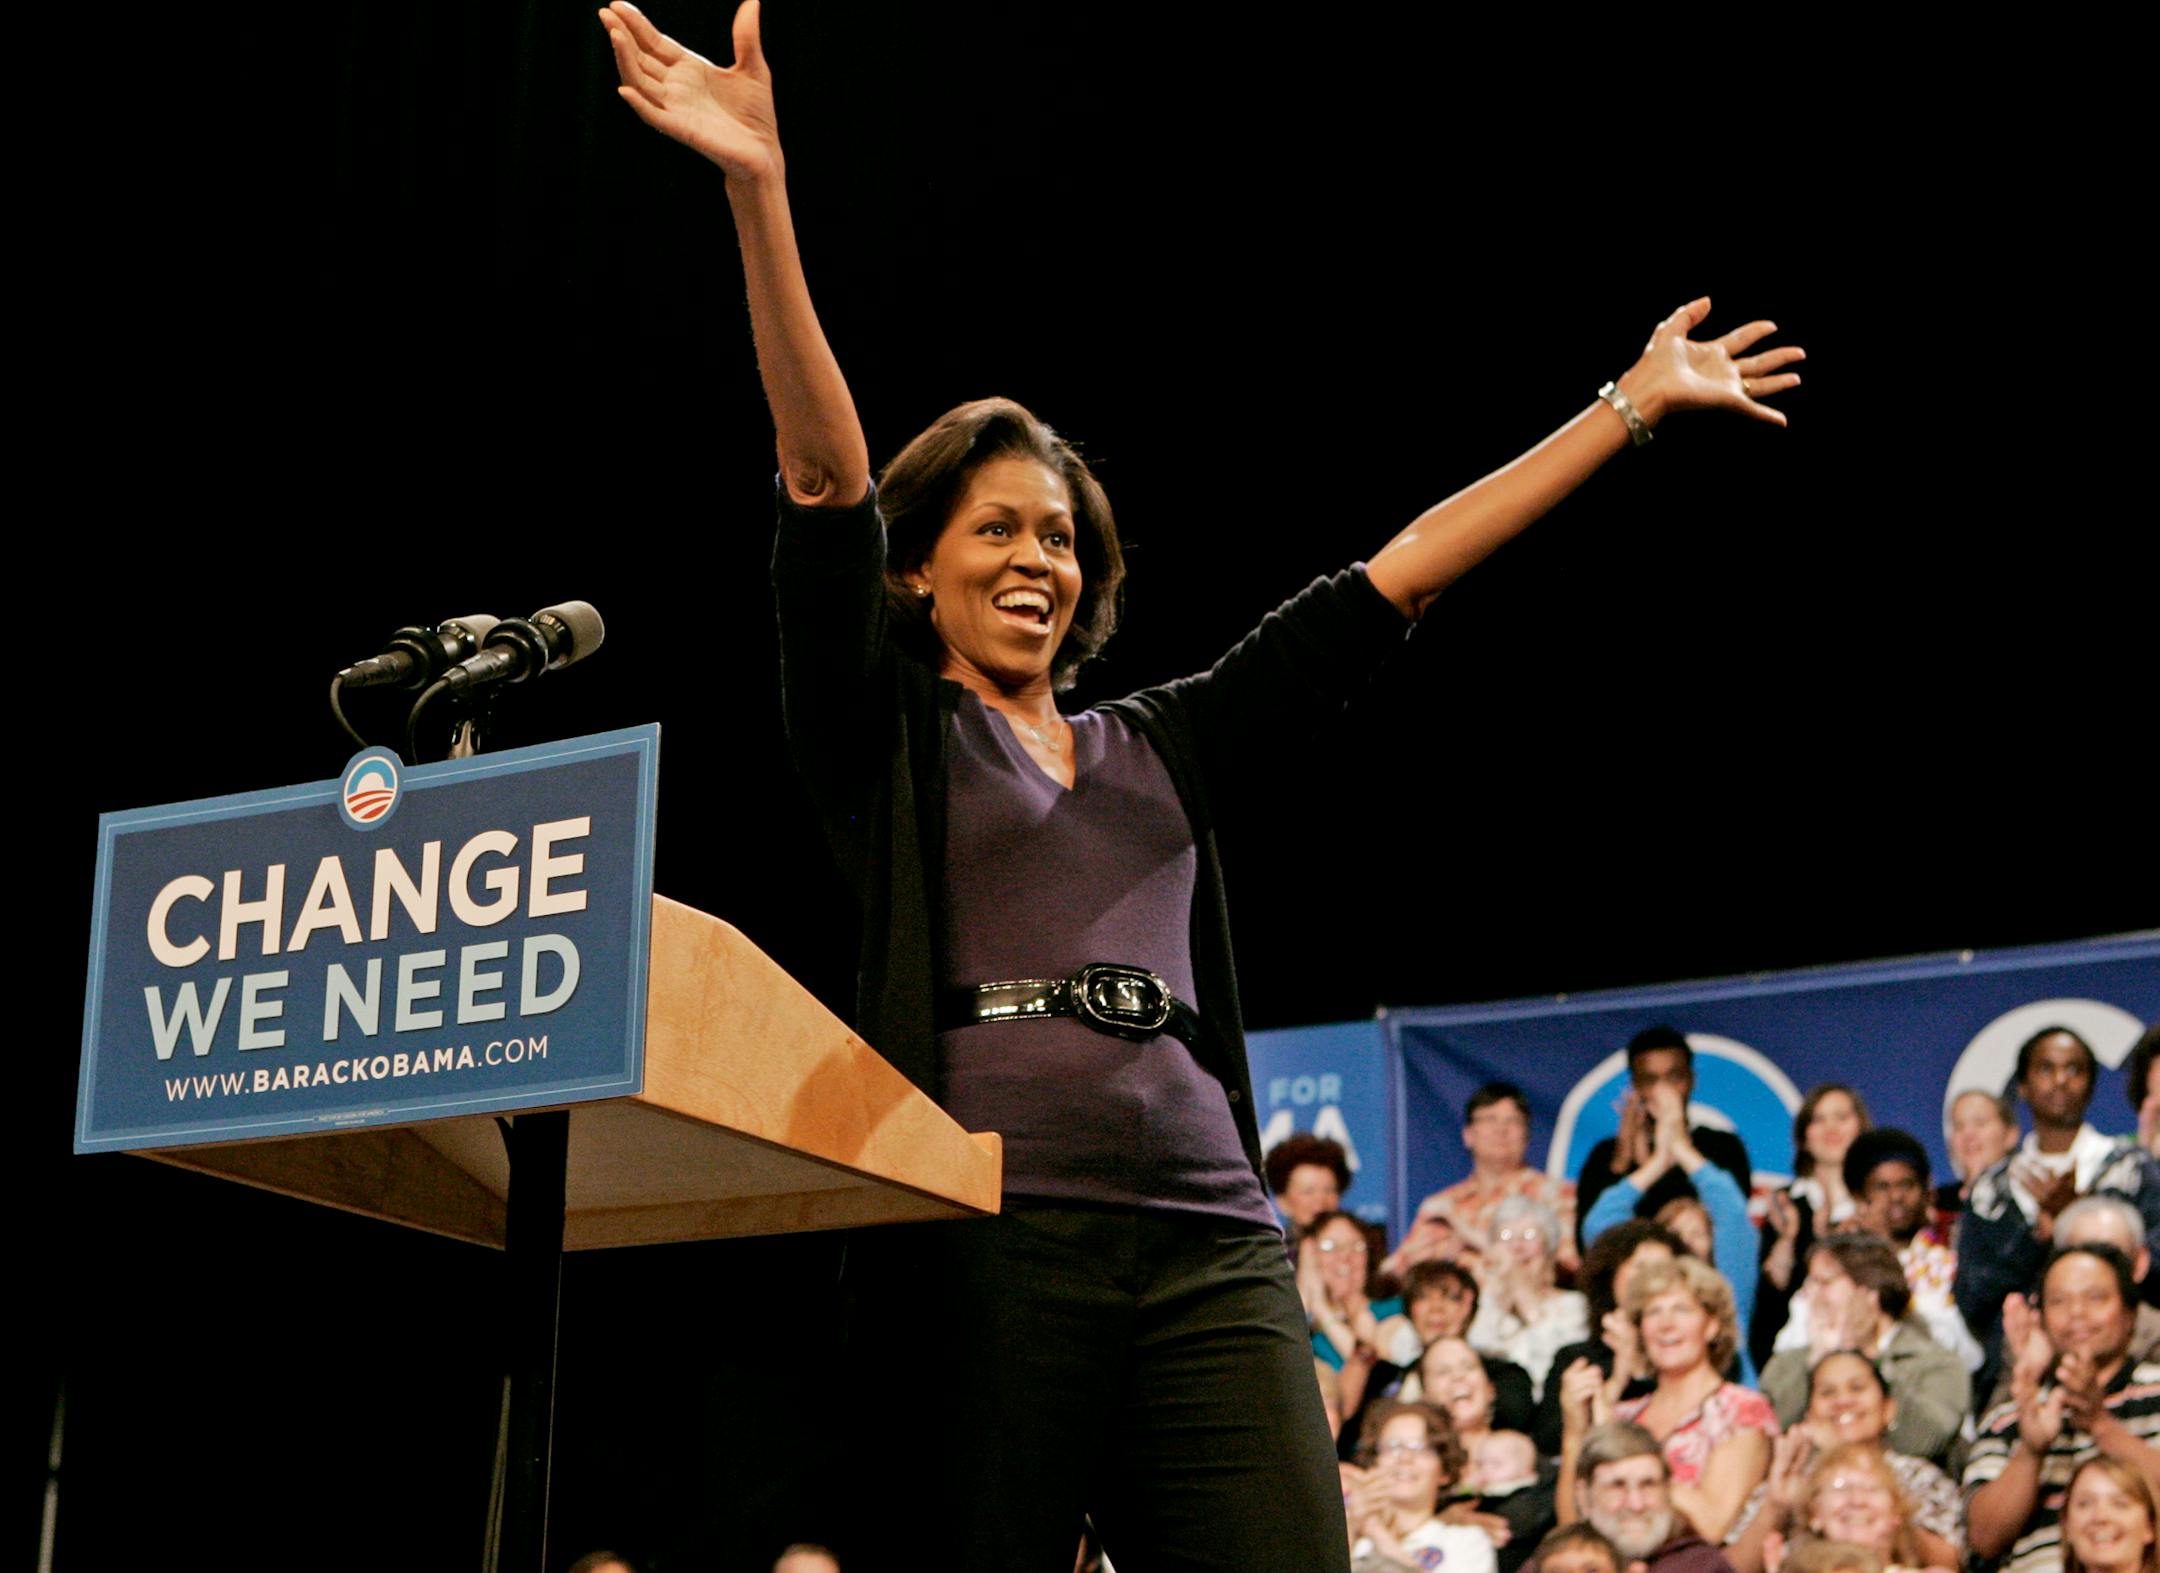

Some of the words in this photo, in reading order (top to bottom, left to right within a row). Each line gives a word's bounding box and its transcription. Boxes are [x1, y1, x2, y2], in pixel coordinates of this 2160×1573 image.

[146, 815, 592, 968] CHANGE
[143, 969, 289, 1061] WE
[322, 933, 581, 1042] NEED
[164, 1035, 549, 1103] WWW.BARACKOBAMA.COM
[1268, 1072, 1342, 1106] FOR
